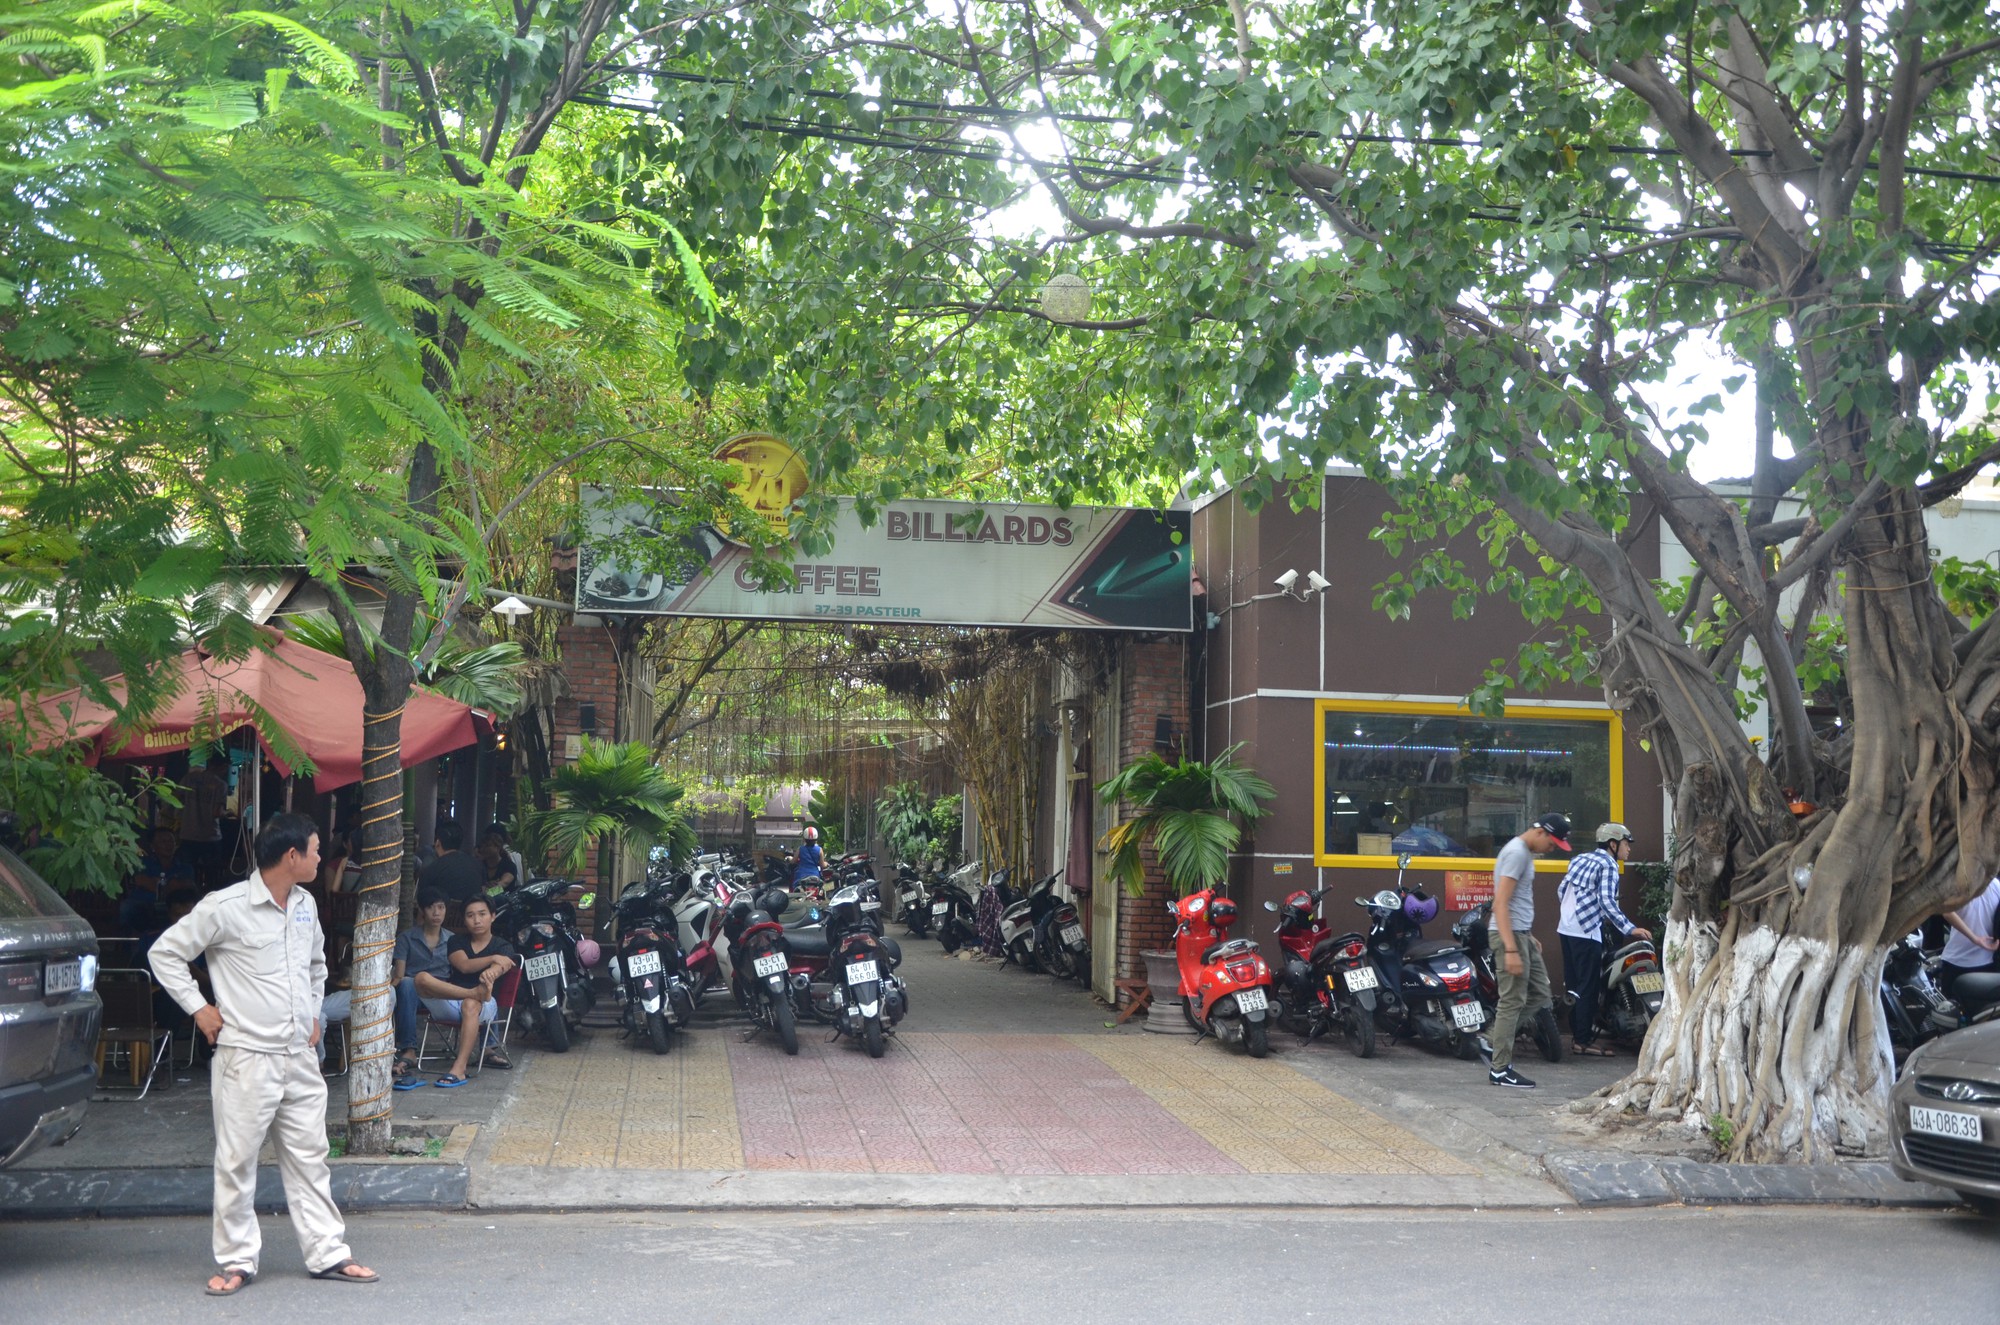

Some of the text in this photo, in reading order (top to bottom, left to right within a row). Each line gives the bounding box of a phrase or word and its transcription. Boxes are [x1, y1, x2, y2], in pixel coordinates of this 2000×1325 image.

[887, 511, 1075, 547] BILLARDS
[733, 561, 881, 597] CFFEE
[814, 604, 921, 618] 37-39 PASTEUR
[530, 956, 552, 968] 43-E1
[759, 955, 780, 967] 43-C1
[1240, 990, 1262, 1002] 43-R2
[1243, 1000, 1265, 1012] 2335
[1457, 1013, 1482, 1026] 607.23
[1912, 1108, 1978, 1138] 43A-086.39
